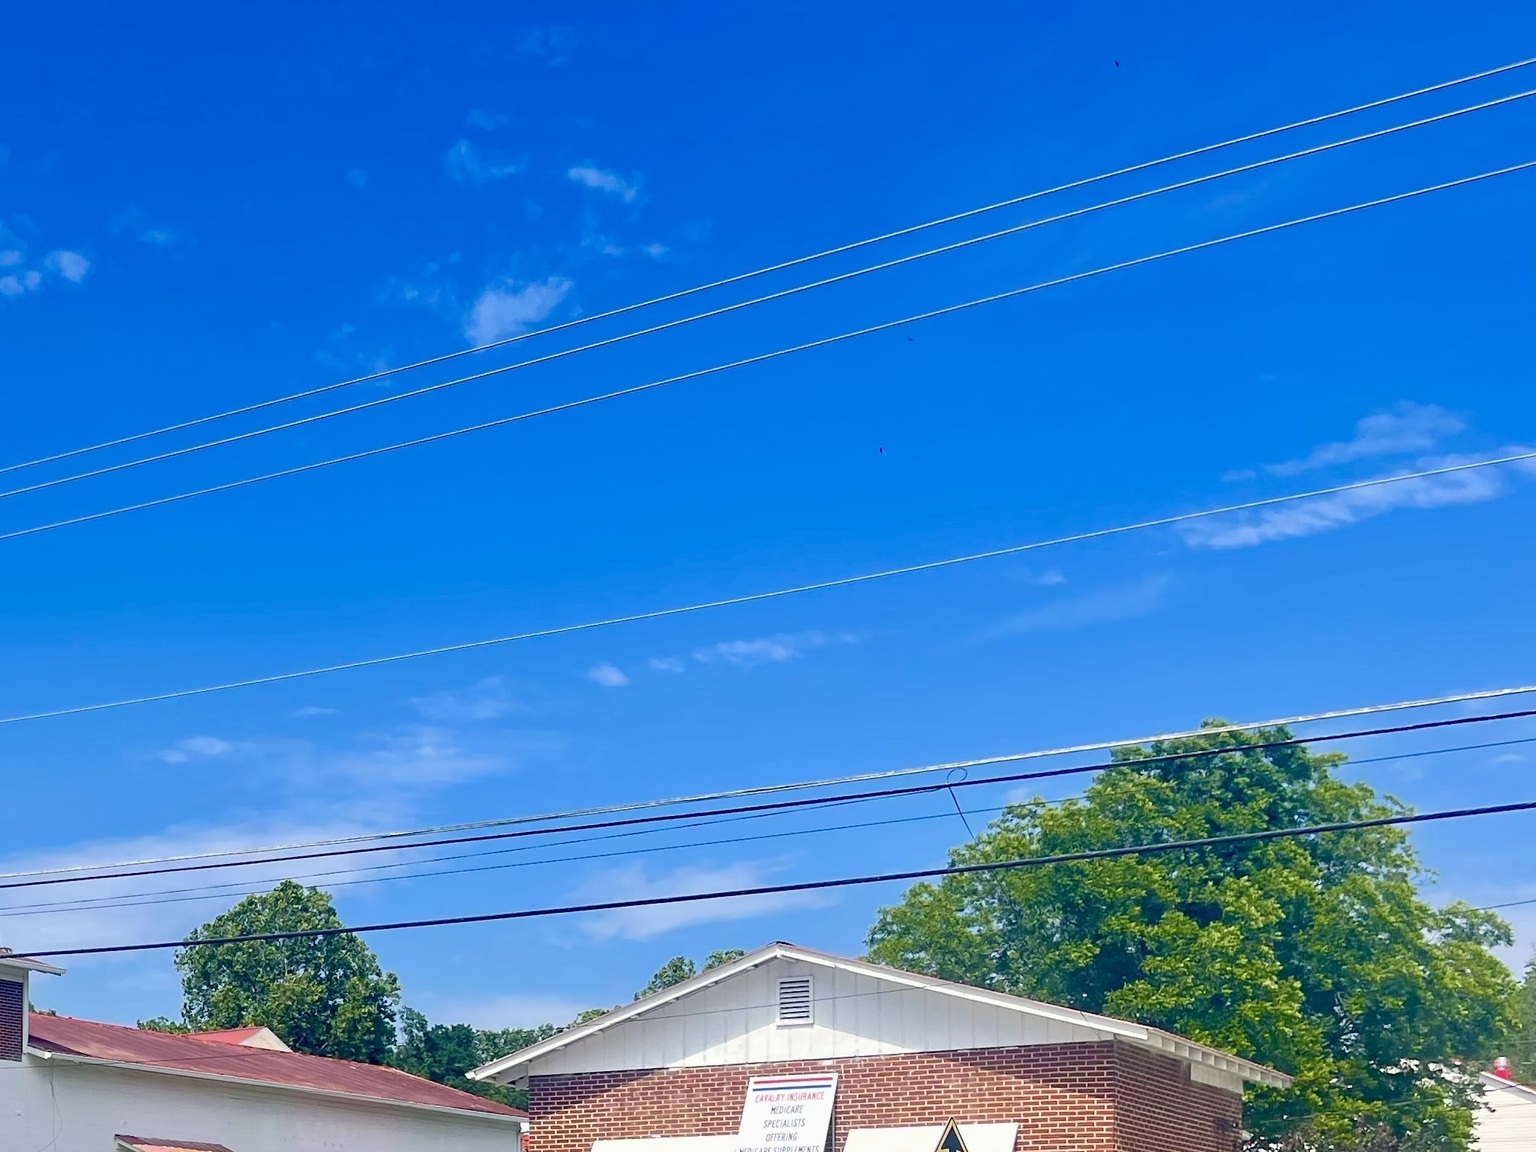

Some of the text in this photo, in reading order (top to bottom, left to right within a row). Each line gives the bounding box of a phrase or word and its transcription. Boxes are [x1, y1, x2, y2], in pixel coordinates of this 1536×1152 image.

[755, 1091, 825, 1103] CAVALRY INSURANCE
[770, 1105, 804, 1114] MEDICARE
[763, 1118, 806, 1128] SPECIALISTS
[765, 1132, 798, 1142] OFFERING
